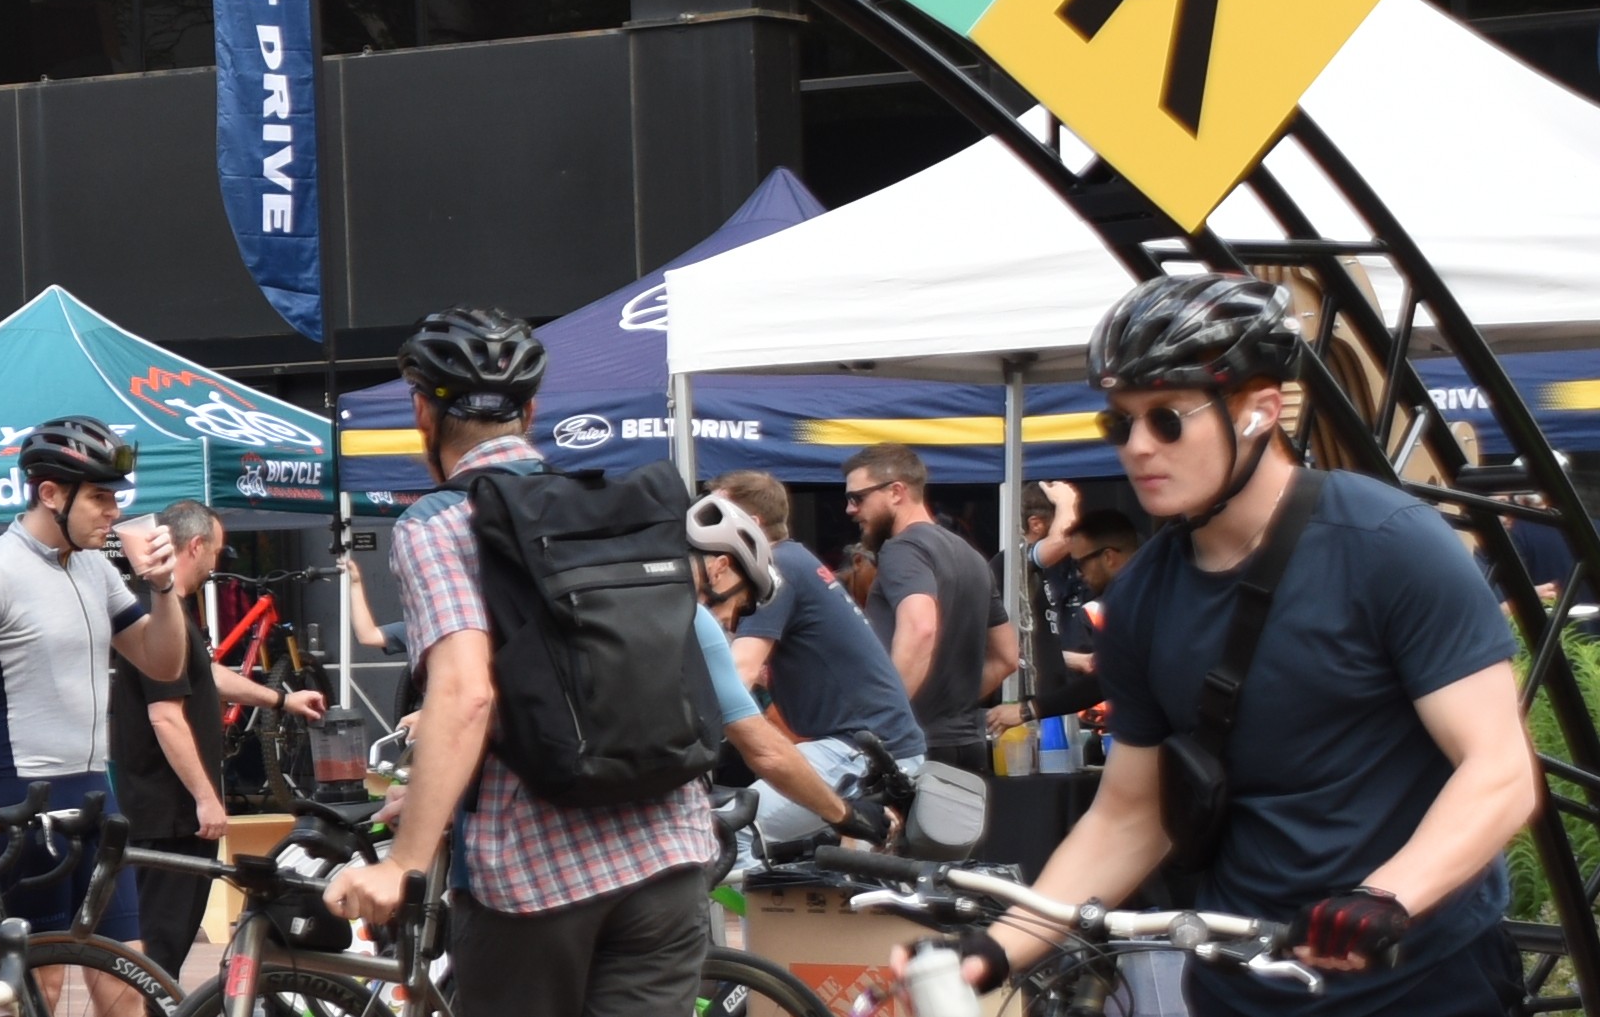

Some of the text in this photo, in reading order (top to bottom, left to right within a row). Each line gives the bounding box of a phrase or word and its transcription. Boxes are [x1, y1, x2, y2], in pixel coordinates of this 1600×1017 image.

[256, 24, 293, 233] DRIVE
[560, 417, 609, 445] Gates
[622, 418, 674, 438] BELT
[266, 459, 322, 485] BICYCLE
[643, 562, 675, 573] THULE
[112, 957, 162, 994] SWISS
